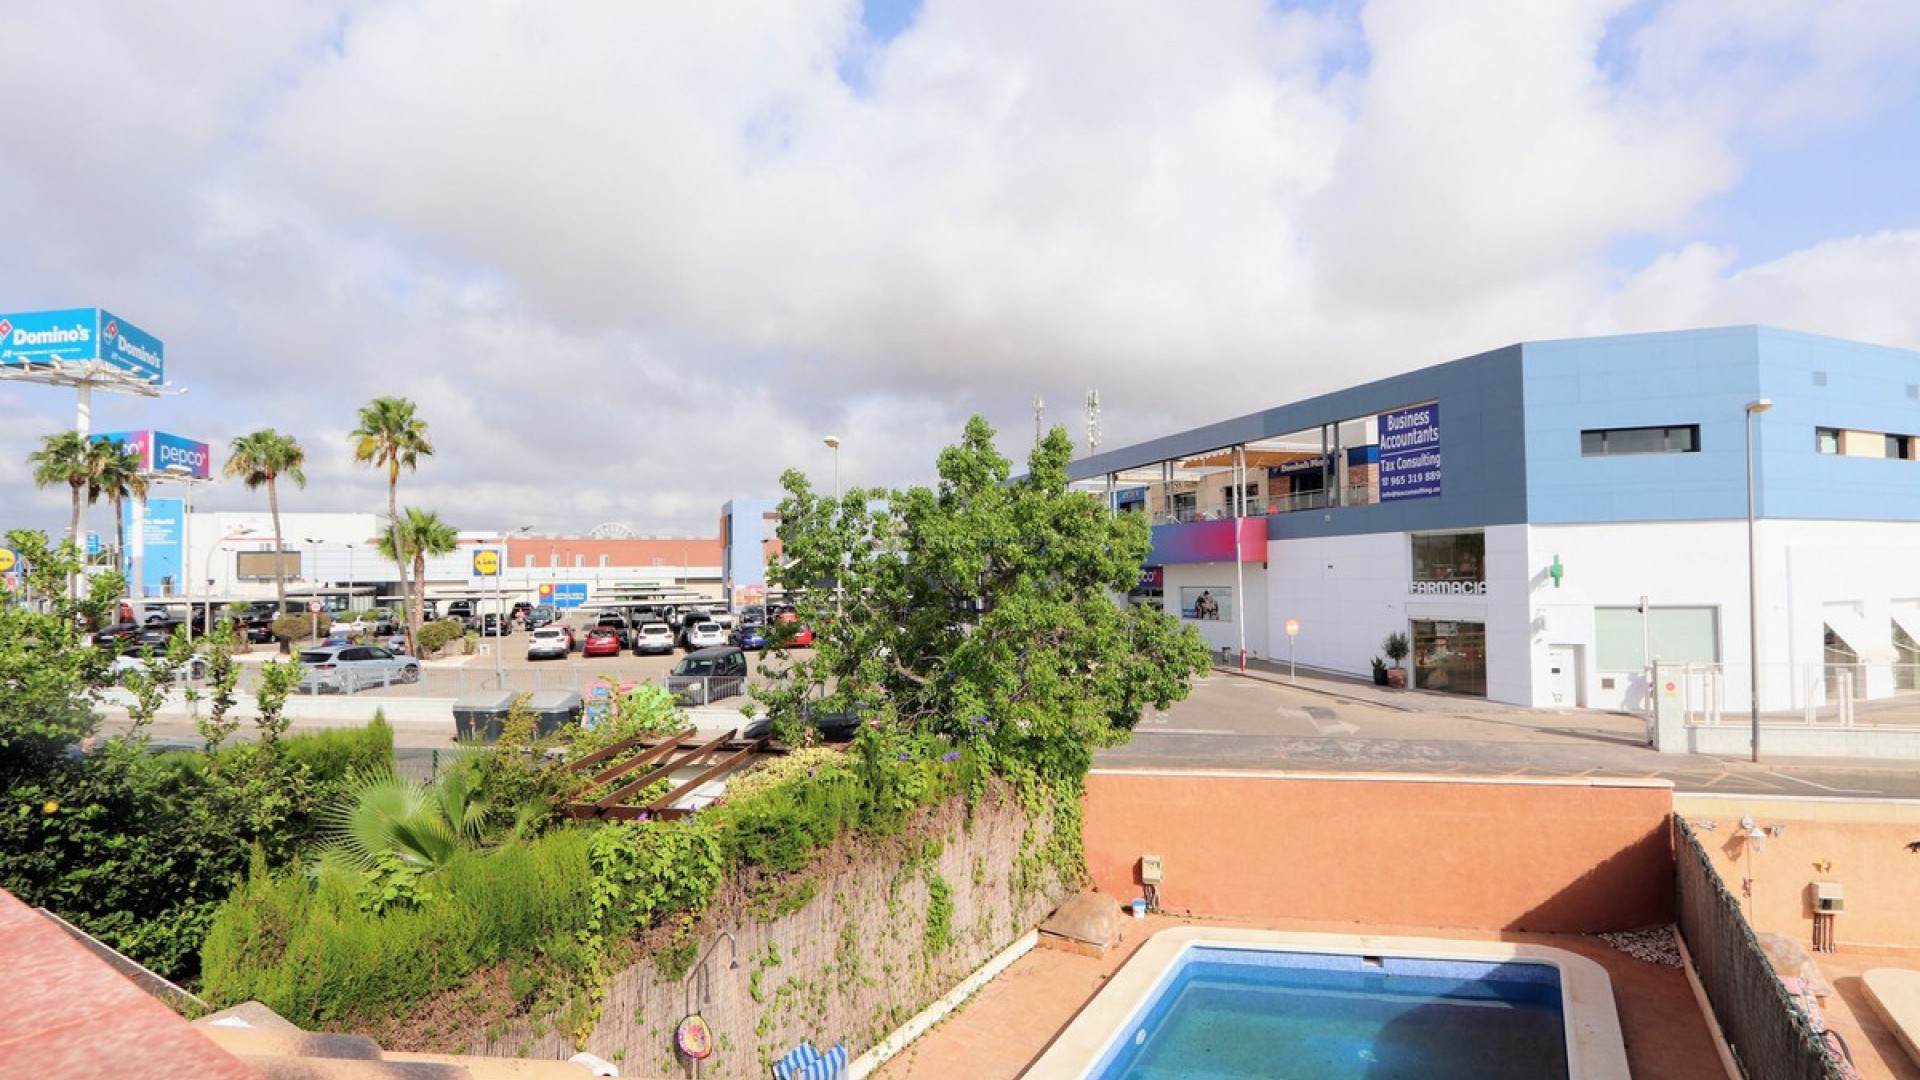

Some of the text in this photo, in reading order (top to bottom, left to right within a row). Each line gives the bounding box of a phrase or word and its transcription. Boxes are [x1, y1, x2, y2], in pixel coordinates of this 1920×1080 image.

[13, 324, 90, 346] Domino's
[118, 335, 161, 369] Domino's
[1387, 410, 1430, 431] Business
[1380, 425, 1439, 450] Accountants
[161, 444, 203, 466] pepco
[1380, 452, 1440, 472] Tax Consulting
[1390, 470, 1441, 486] 965 319 889
[1410, 580, 1488, 595] FARMACIA
